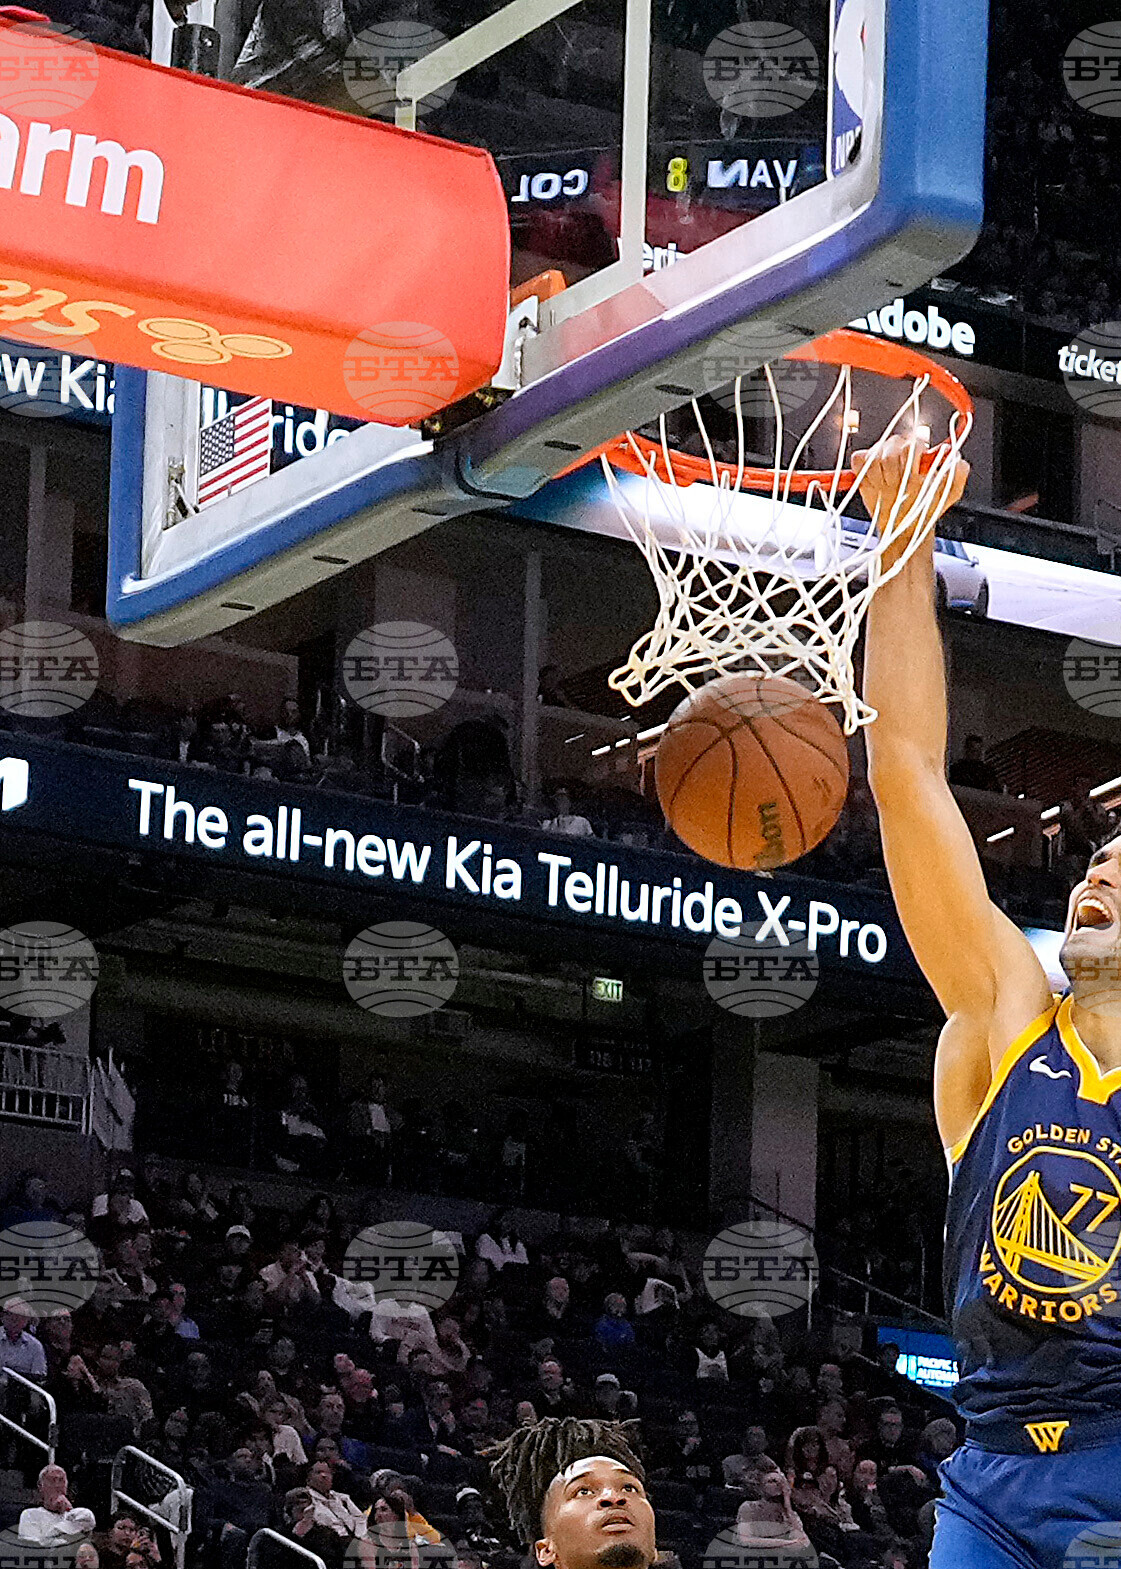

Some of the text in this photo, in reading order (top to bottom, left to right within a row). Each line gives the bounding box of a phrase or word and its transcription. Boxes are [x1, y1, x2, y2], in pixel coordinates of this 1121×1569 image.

[128, 778, 888, 963] The all-new Kia Telluride X-Pro
[1007, 1124, 1091, 1154] GOLDEN
[1061, 1182, 1120, 1233] 77
[979, 1241, 1118, 1323] WARRIORS
